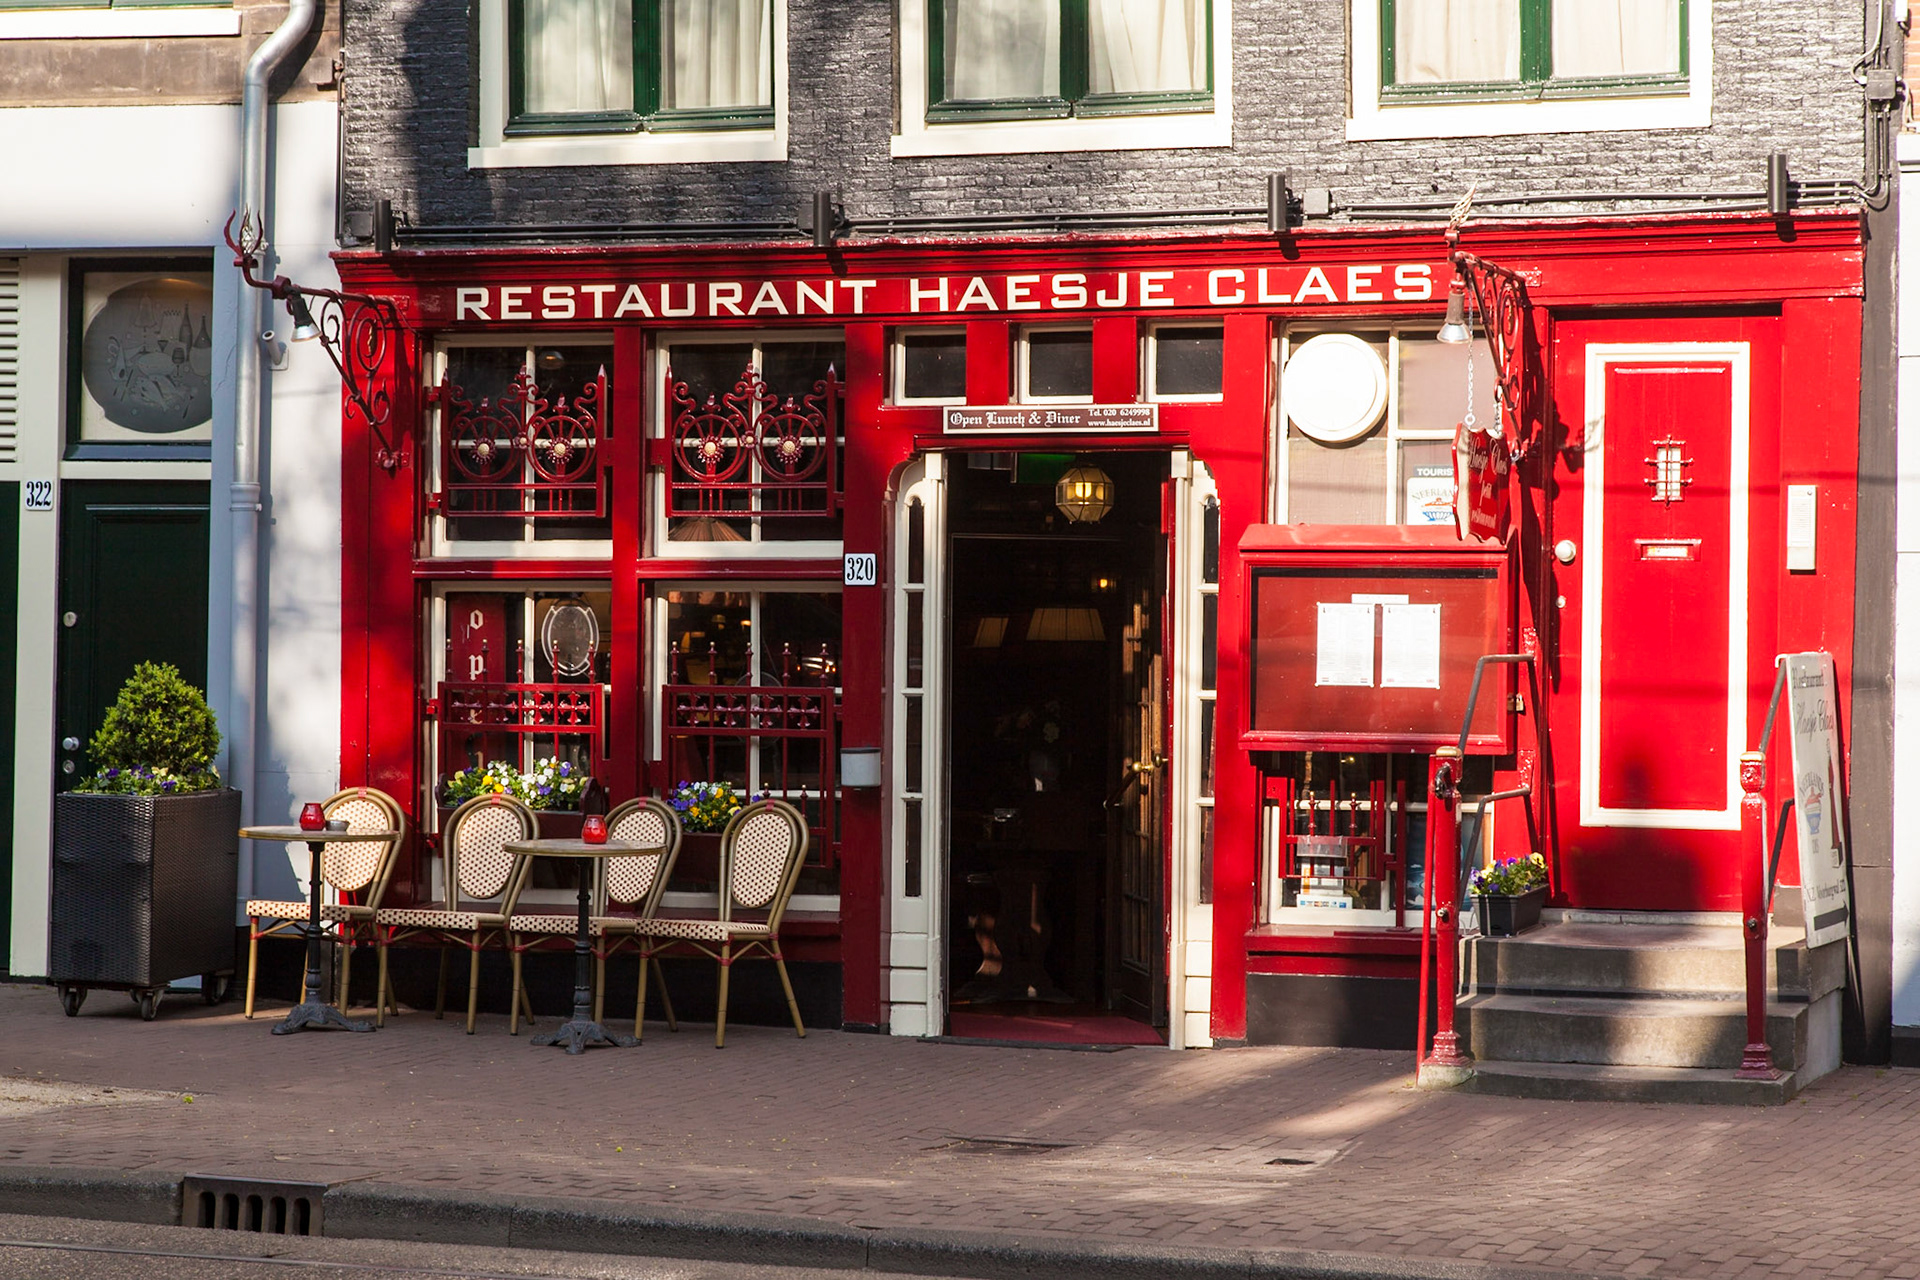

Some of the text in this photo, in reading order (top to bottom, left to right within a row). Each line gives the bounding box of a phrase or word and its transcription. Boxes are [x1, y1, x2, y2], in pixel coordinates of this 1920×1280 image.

[456, 263, 1432, 321] RESTAURANT HAESJE CLAES
[950, 410, 1081, 428] Open Lunch & Diner
[1103, 408, 1117, 417] 020
[1120, 408, 1151, 417] 6249998
[1087, 418, 1151, 428] www.haesjeclaes.nl
[1416, 468, 1454, 477] TOURIS
[26, 480, 52, 507] 322
[846, 557, 874, 581] 320
